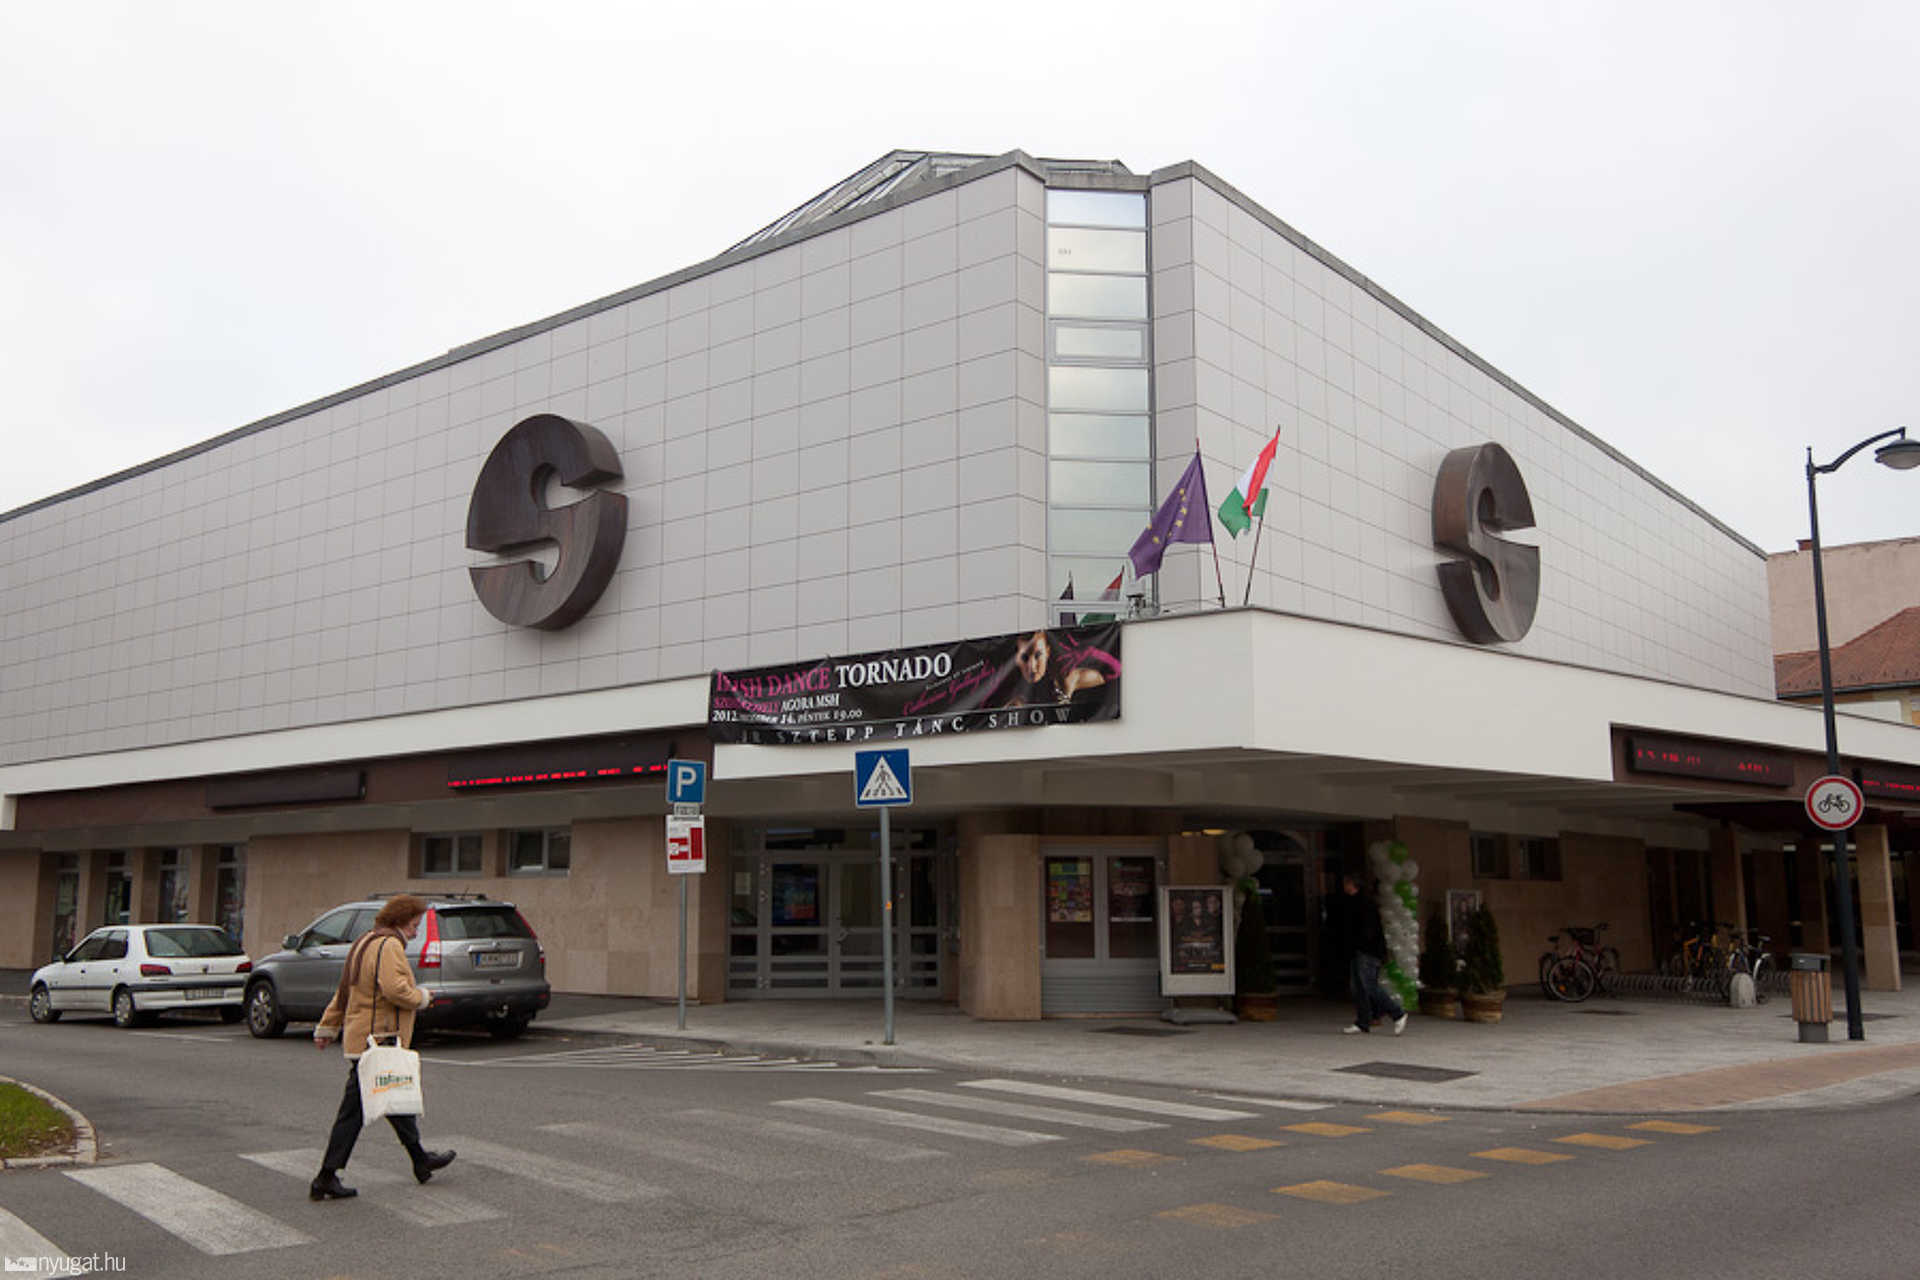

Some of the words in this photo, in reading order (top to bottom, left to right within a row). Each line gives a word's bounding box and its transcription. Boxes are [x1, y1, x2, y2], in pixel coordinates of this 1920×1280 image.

[768, 667, 831, 697] DANCE
[834, 652, 952, 688] TORNADO
[781, 695, 814, 712] AGORA
[988, 708, 1072, 728] SHOW
[676, 765, 697, 798] P
